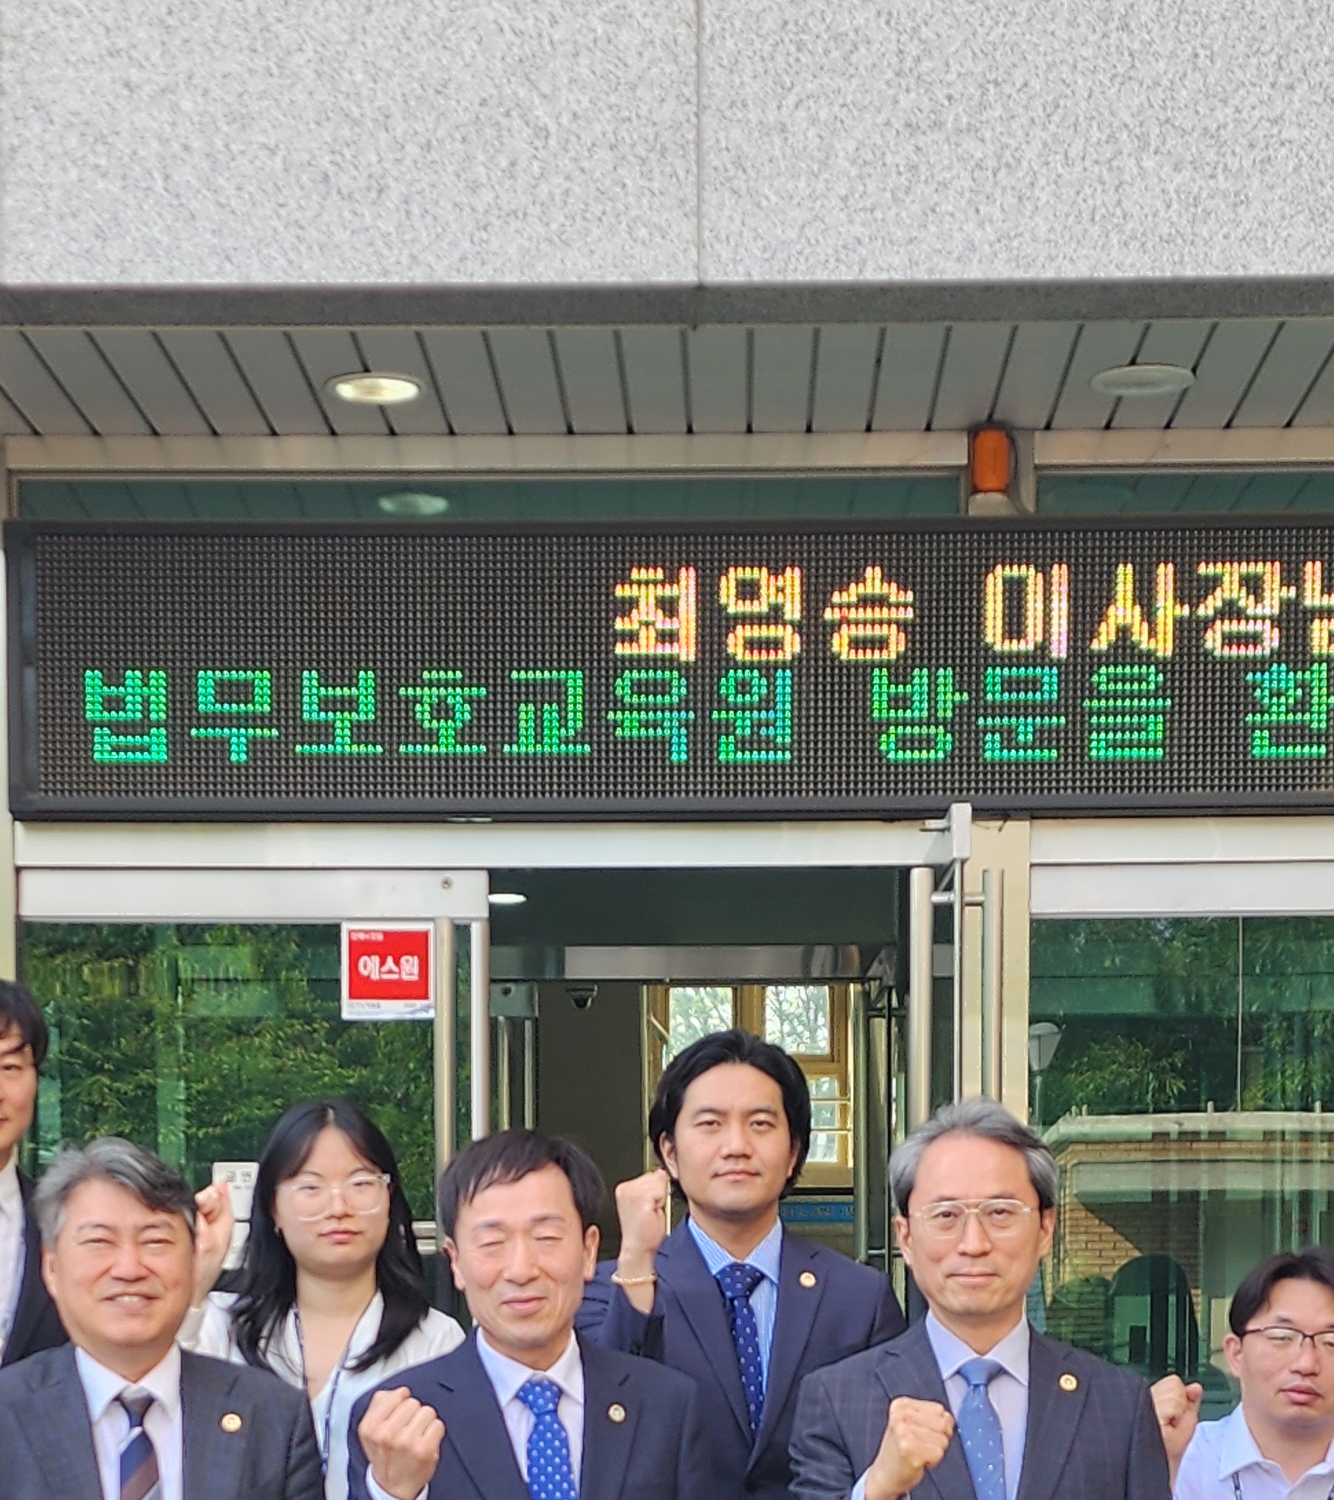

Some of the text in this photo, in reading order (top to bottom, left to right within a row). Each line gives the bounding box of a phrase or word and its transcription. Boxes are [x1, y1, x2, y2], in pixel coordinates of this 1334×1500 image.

[614, 564, 914, 662] 최영승
[84, 668, 793, 765] 법무보호교육원
[868, 664, 1167, 764] 방문을
[357, 955, 420, 981] 에스원
